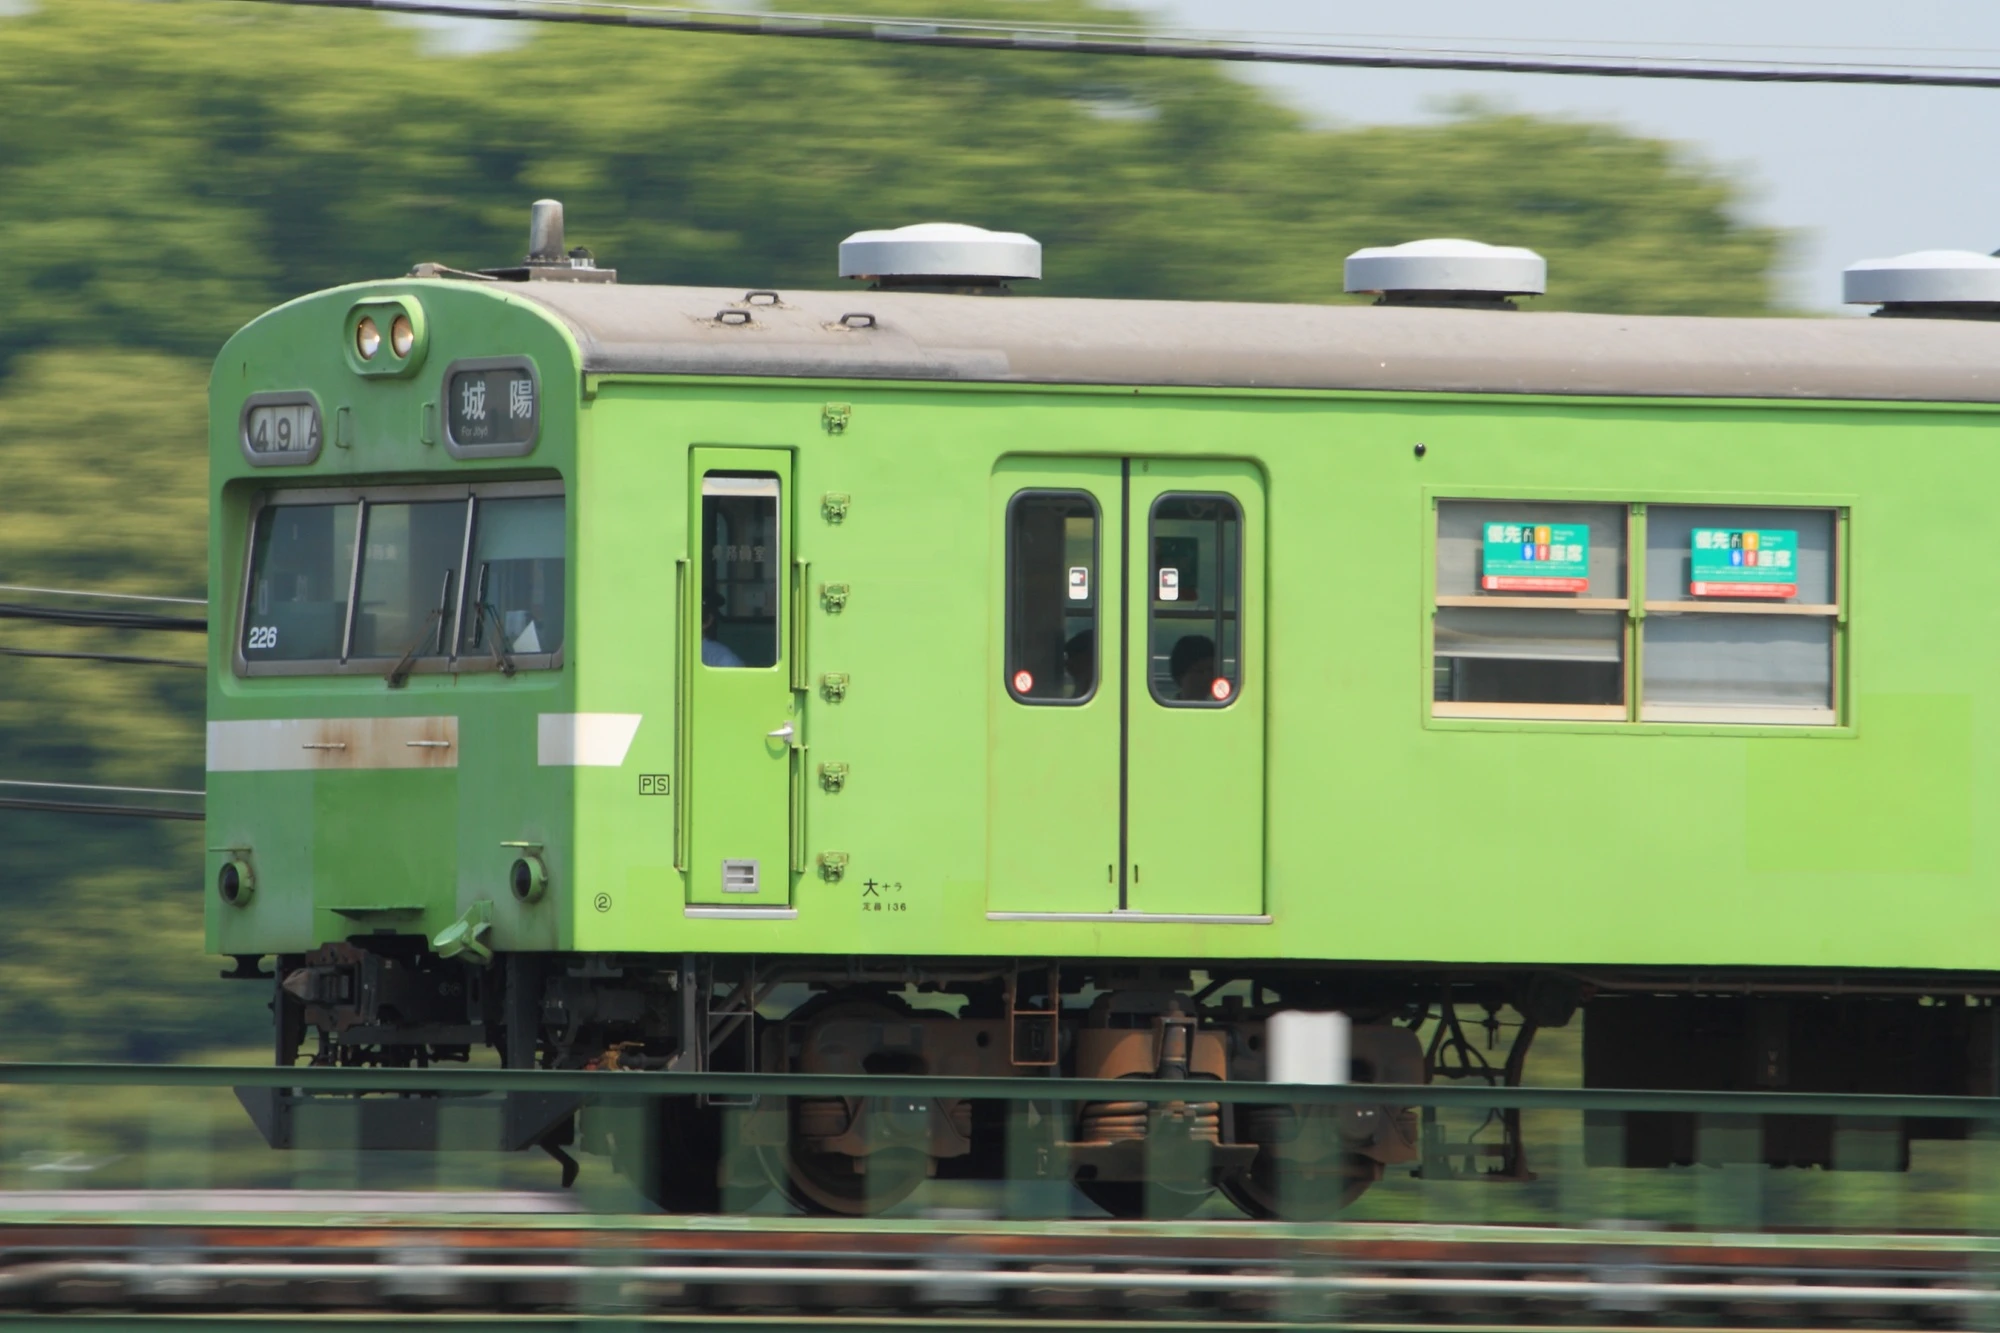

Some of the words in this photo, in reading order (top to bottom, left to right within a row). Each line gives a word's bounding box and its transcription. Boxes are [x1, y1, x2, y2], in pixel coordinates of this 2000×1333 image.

[461, 380, 533, 420] 城陽
[248, 626, 278, 648] 226
[888, 902, 906, 912] 136
